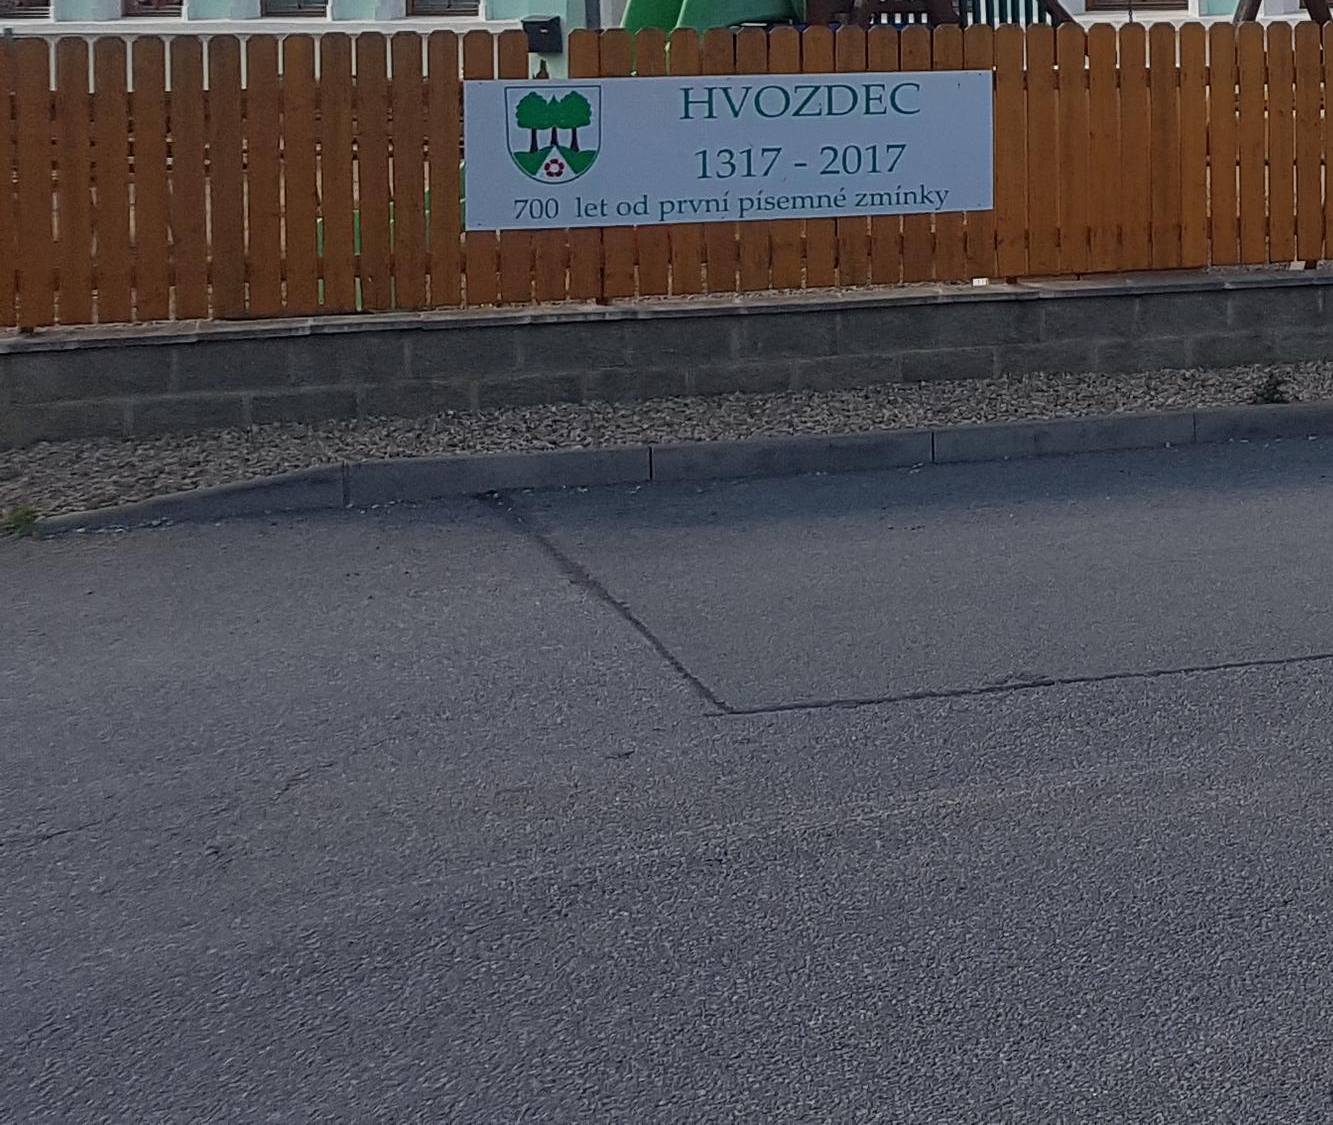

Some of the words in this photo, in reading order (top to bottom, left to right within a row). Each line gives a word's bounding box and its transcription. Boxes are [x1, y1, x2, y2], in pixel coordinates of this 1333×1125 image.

[679, 82, 921, 120] HVOZDEC
[694, 146, 782, 179] 1317
[819, 143, 908, 175] 2017
[513, 198, 560, 220] 700
[575, 196, 608, 218] let
[615, 194, 649, 217] od
[658, 191, 730, 221] první
[737, 187, 847, 218] písemné
[854, 184, 950, 211] zmínky
